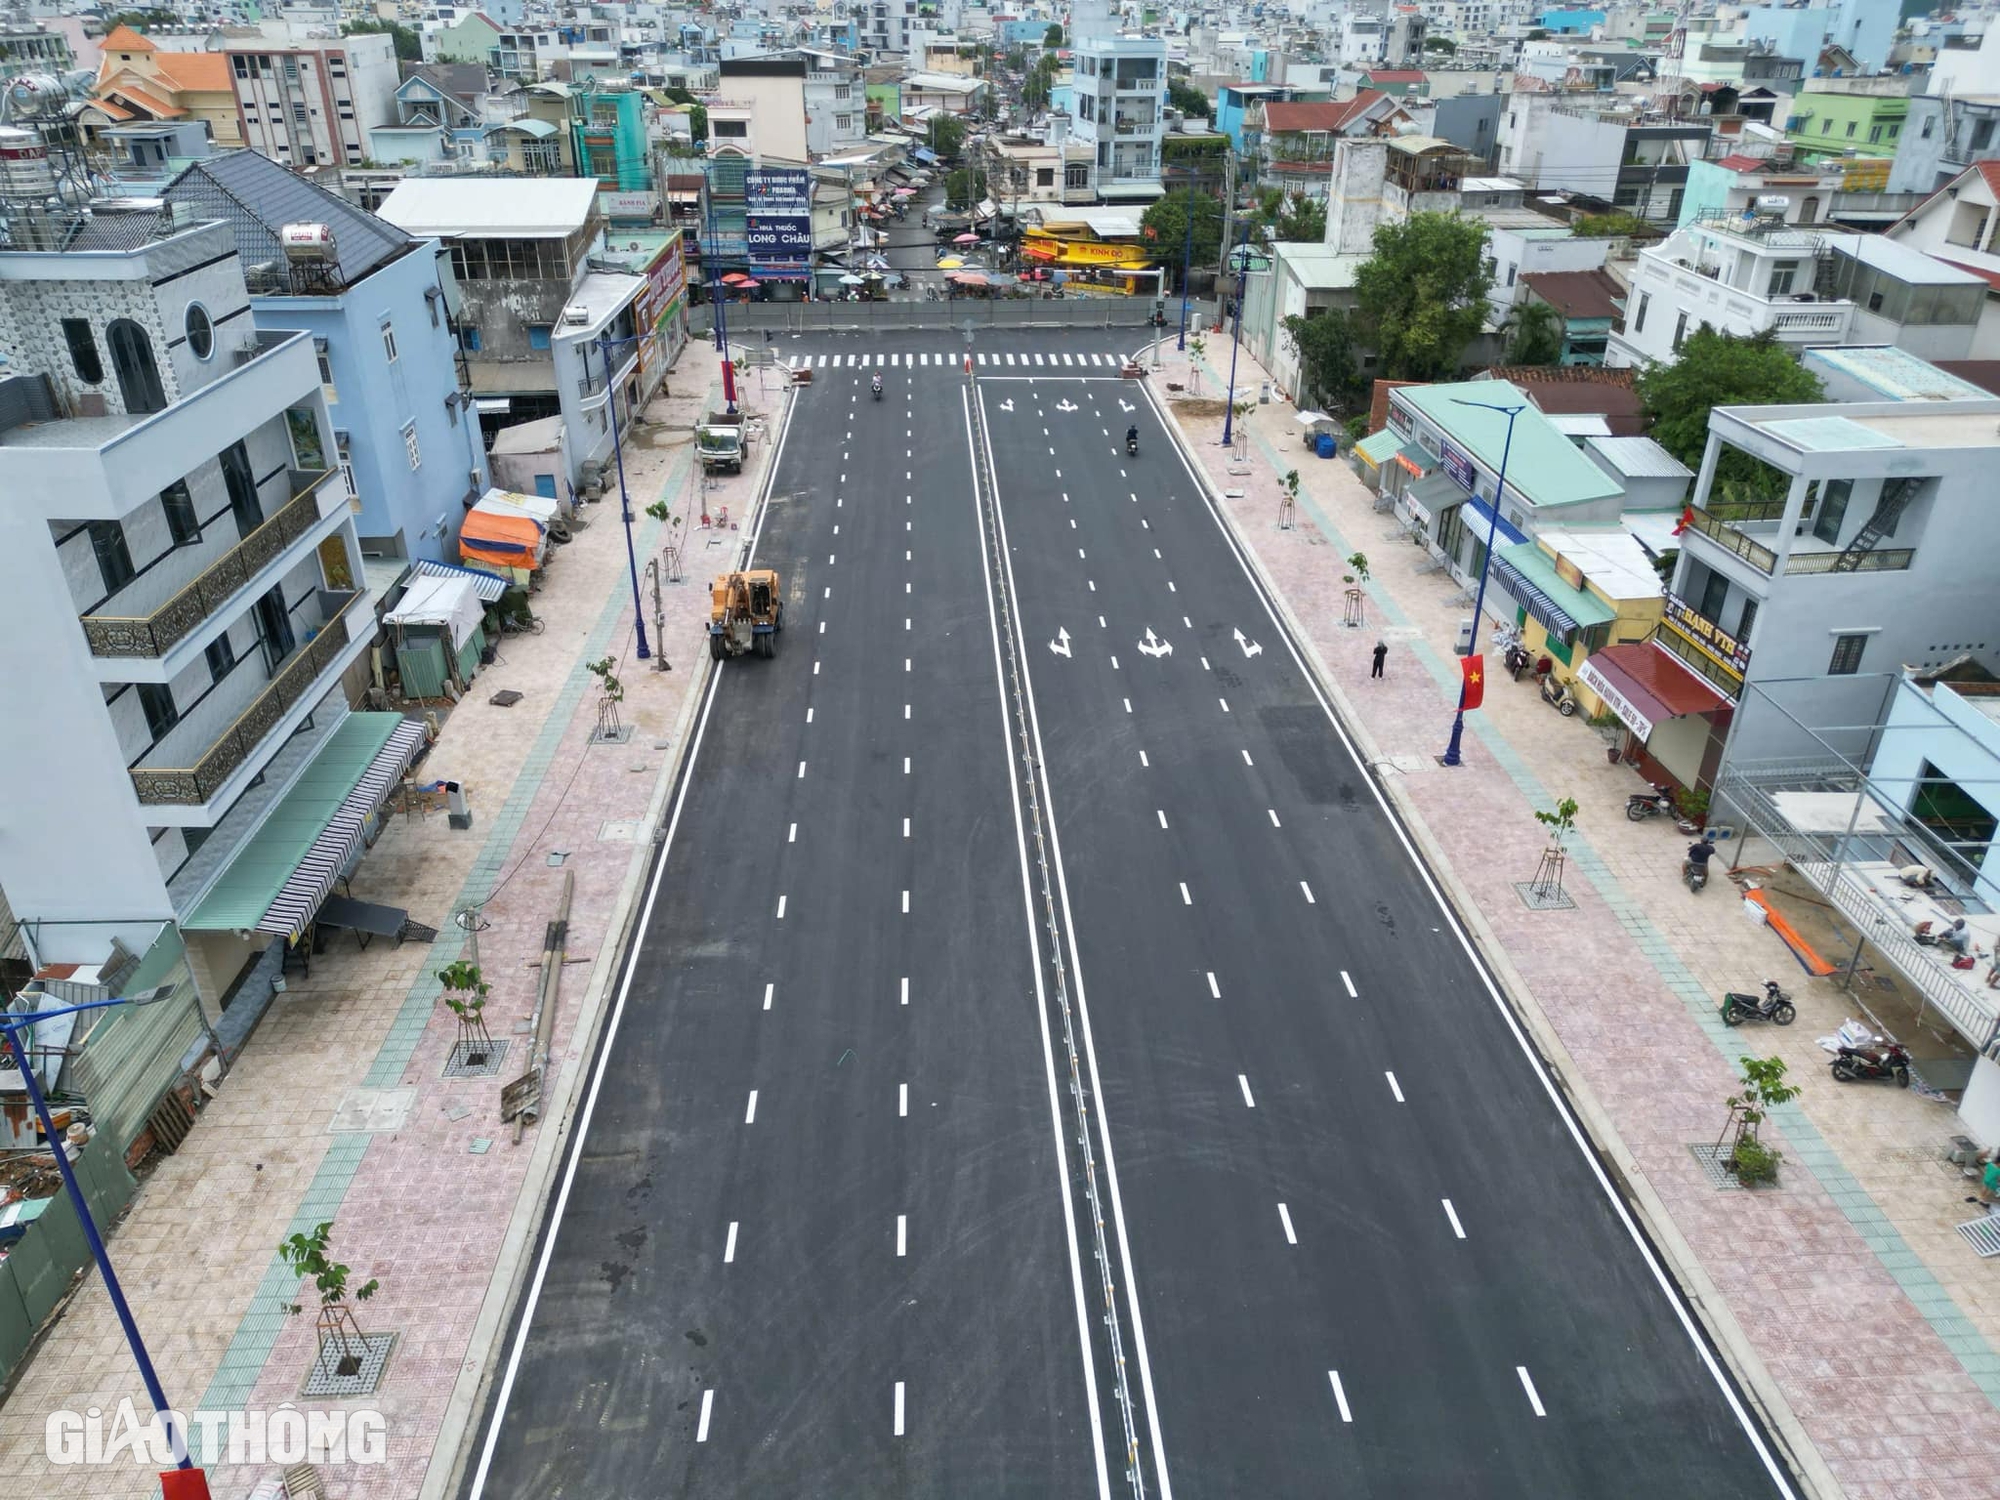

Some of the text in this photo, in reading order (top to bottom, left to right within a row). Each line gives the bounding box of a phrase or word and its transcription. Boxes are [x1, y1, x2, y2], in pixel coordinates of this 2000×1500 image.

[748, 232, 810, 243] LONG CHÂU
[1683, 608, 1714, 639] HẠNH
[1714, 629, 1737, 656] VTH
